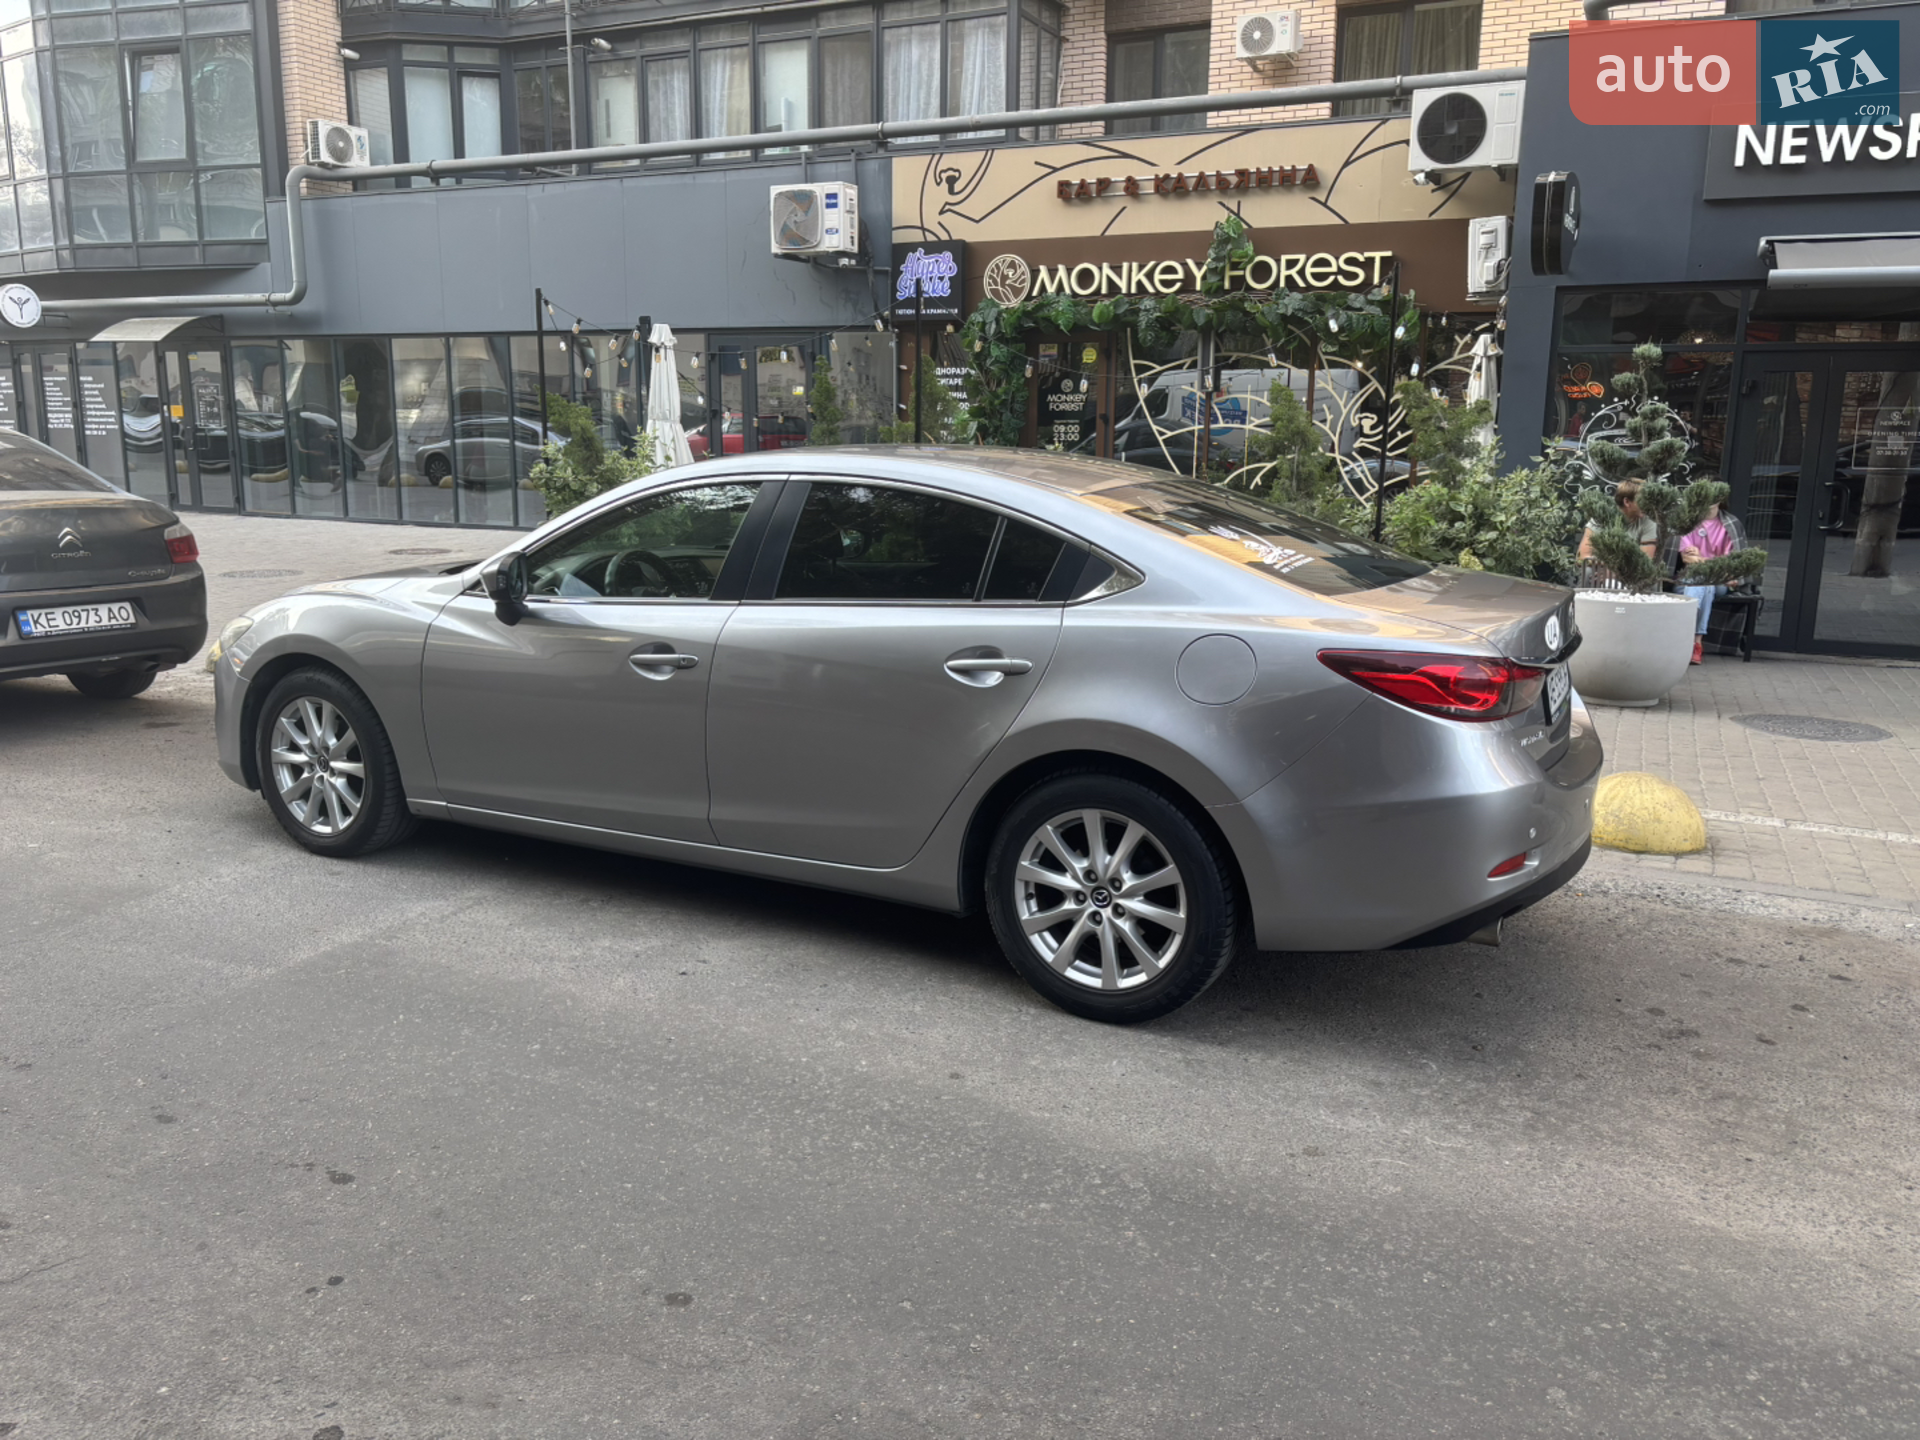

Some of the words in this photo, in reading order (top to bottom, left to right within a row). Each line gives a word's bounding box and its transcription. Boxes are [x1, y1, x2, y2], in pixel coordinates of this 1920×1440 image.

[1057, 177, 1112, 199] БАР
[1123, 175, 1140, 196] &
[1153, 163, 1321, 194] КАЛЬЯННА
[1053, 424, 1080, 433] 09:00
[1053, 433, 1080, 441] 23:00
[30, 611, 60, 631] KE
[61, 607, 103, 627] 0973
[107, 605, 131, 623] AO
